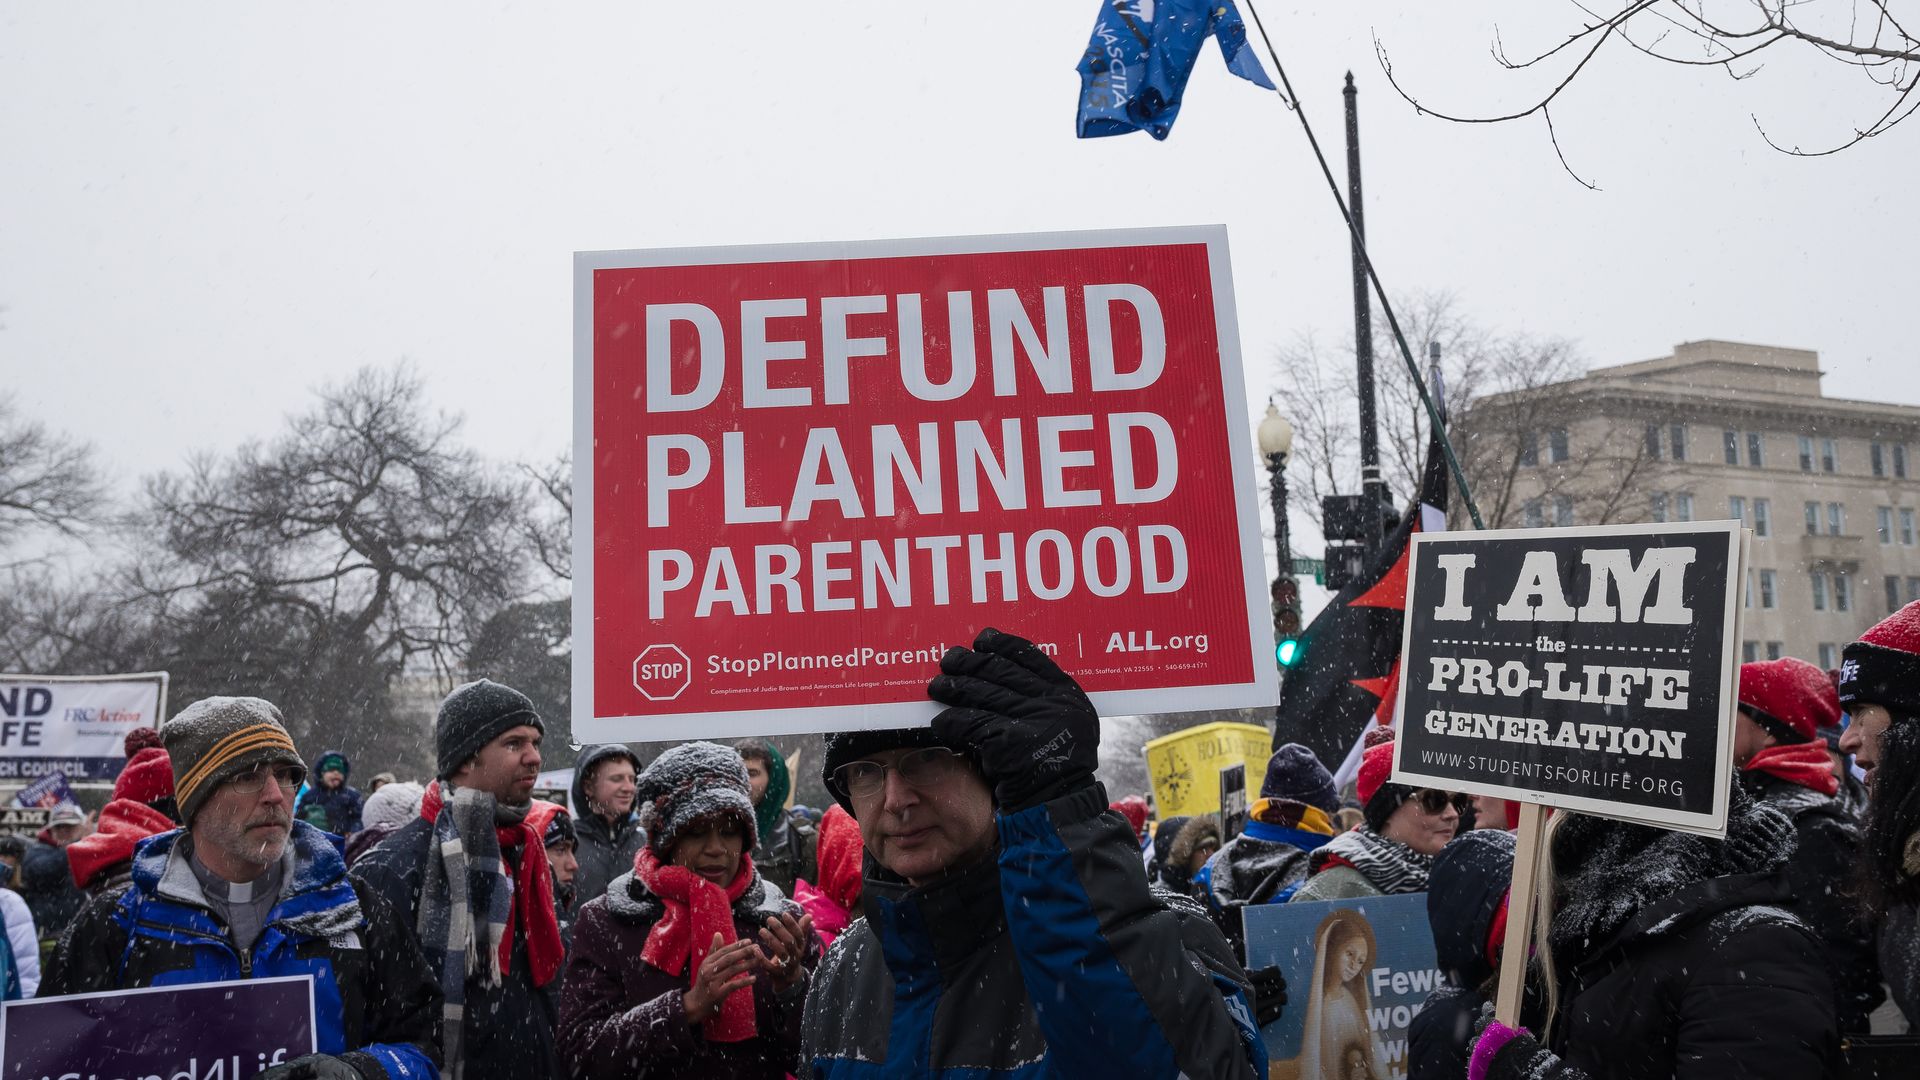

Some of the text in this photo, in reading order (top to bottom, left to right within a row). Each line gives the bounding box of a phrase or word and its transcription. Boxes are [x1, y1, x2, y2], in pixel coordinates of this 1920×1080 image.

[1094, 21, 1128, 109] NASCITA
[646, 283, 1167, 413] DEFUND
[646, 411, 1179, 528] PLANNED
[647, 524, 1189, 620] PARENTHOOD
[1434, 546, 1697, 625] I AM
[1105, 630, 1209, 654] ALL.org
[1535, 635, 1566, 653] the
[641, 662, 683, 681] STOP
[1134, 664, 1154, 673] 22555
[1165, 662, 1208, 671] 540-659-4171
[710, 687, 752, 696] Compliments
[760, 685, 778, 693] Judie
[813, 681, 844, 690] American
[845, 681, 856, 689] Life
[857, 681, 882, 689] League.
[884, 678, 916, 687] Donations
[1427, 656, 1690, 710] PRO-LIFE
[0, 687, 53, 717] ND
[1424, 709, 1687, 760] GENERATION
[21, 760, 89, 777] COUNCIL
